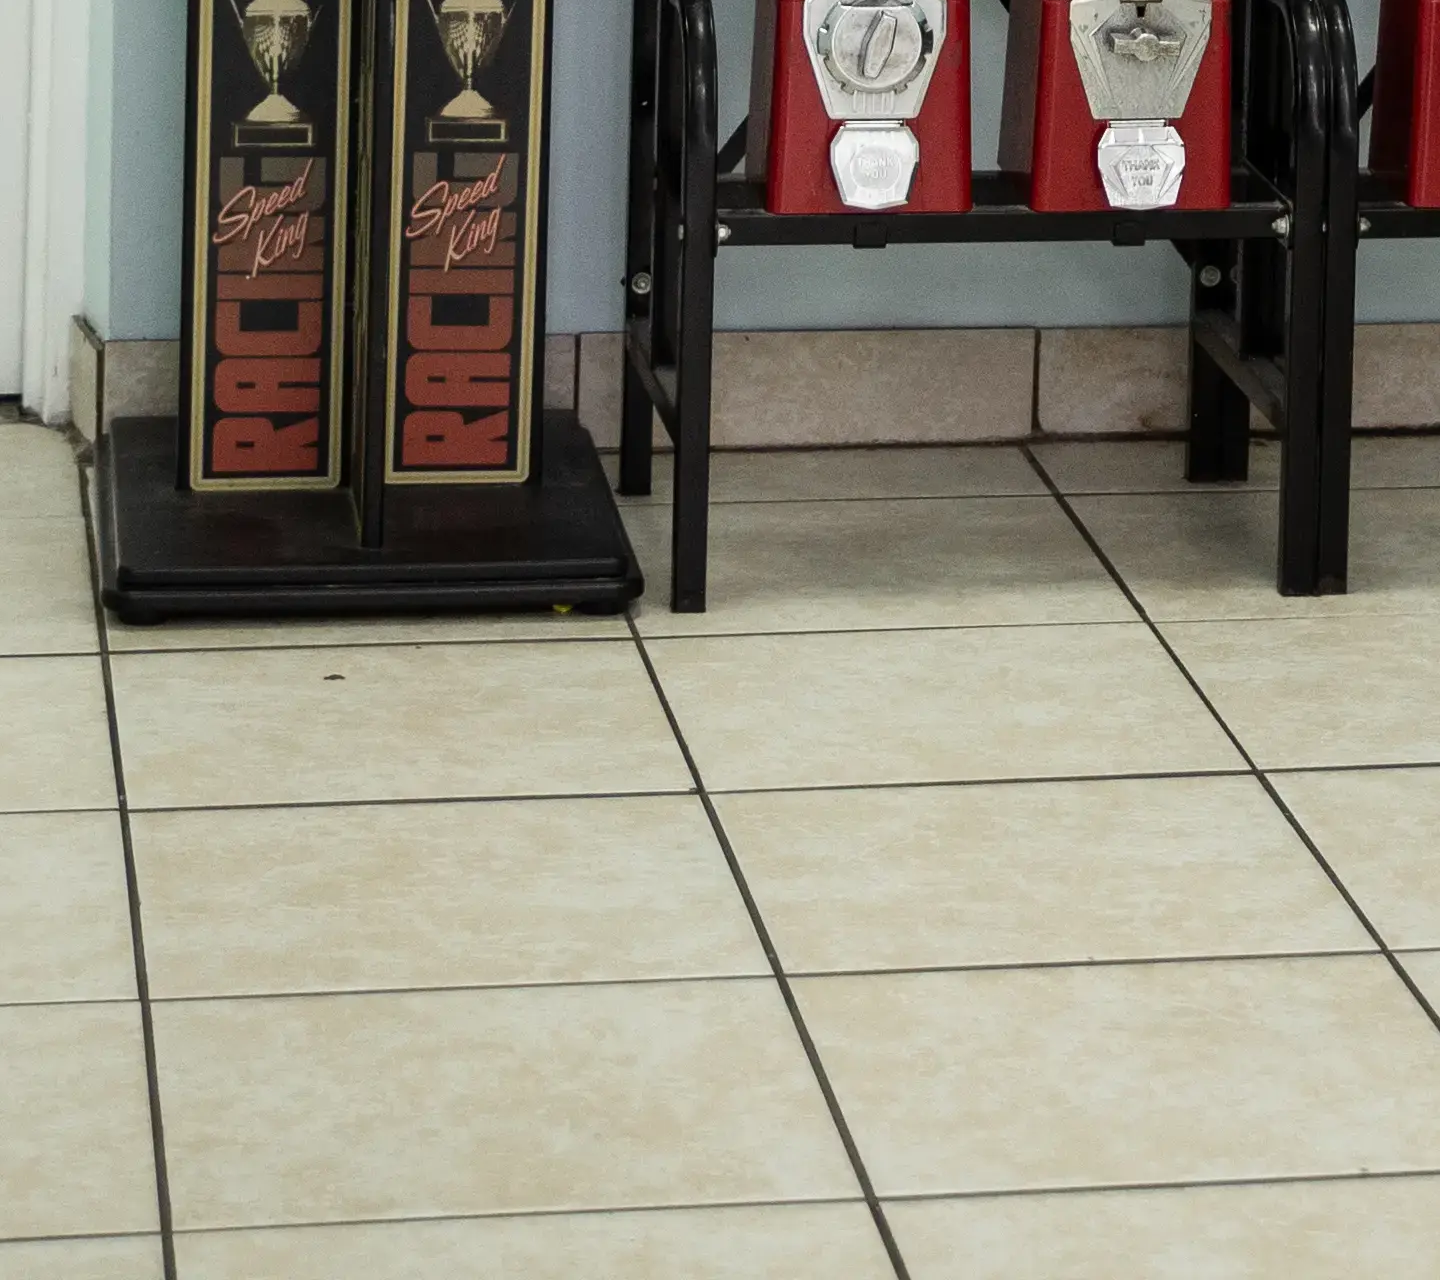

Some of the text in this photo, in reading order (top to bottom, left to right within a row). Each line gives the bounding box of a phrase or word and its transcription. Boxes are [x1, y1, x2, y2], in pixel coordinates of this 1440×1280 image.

[405, 152, 506, 238] Speed
[856, 156, 896, 167] THANK
[863, 168, 888, 180] YOU
[1121, 158, 1161, 172] THANK
[1131, 175, 1153, 187] YOU
[212, 156, 313, 244] Speed
[252, 209, 309, 278] King
[444, 204, 502, 273] King
[212, 156, 327, 472] RACING
[402, 151, 520, 467] RACING
